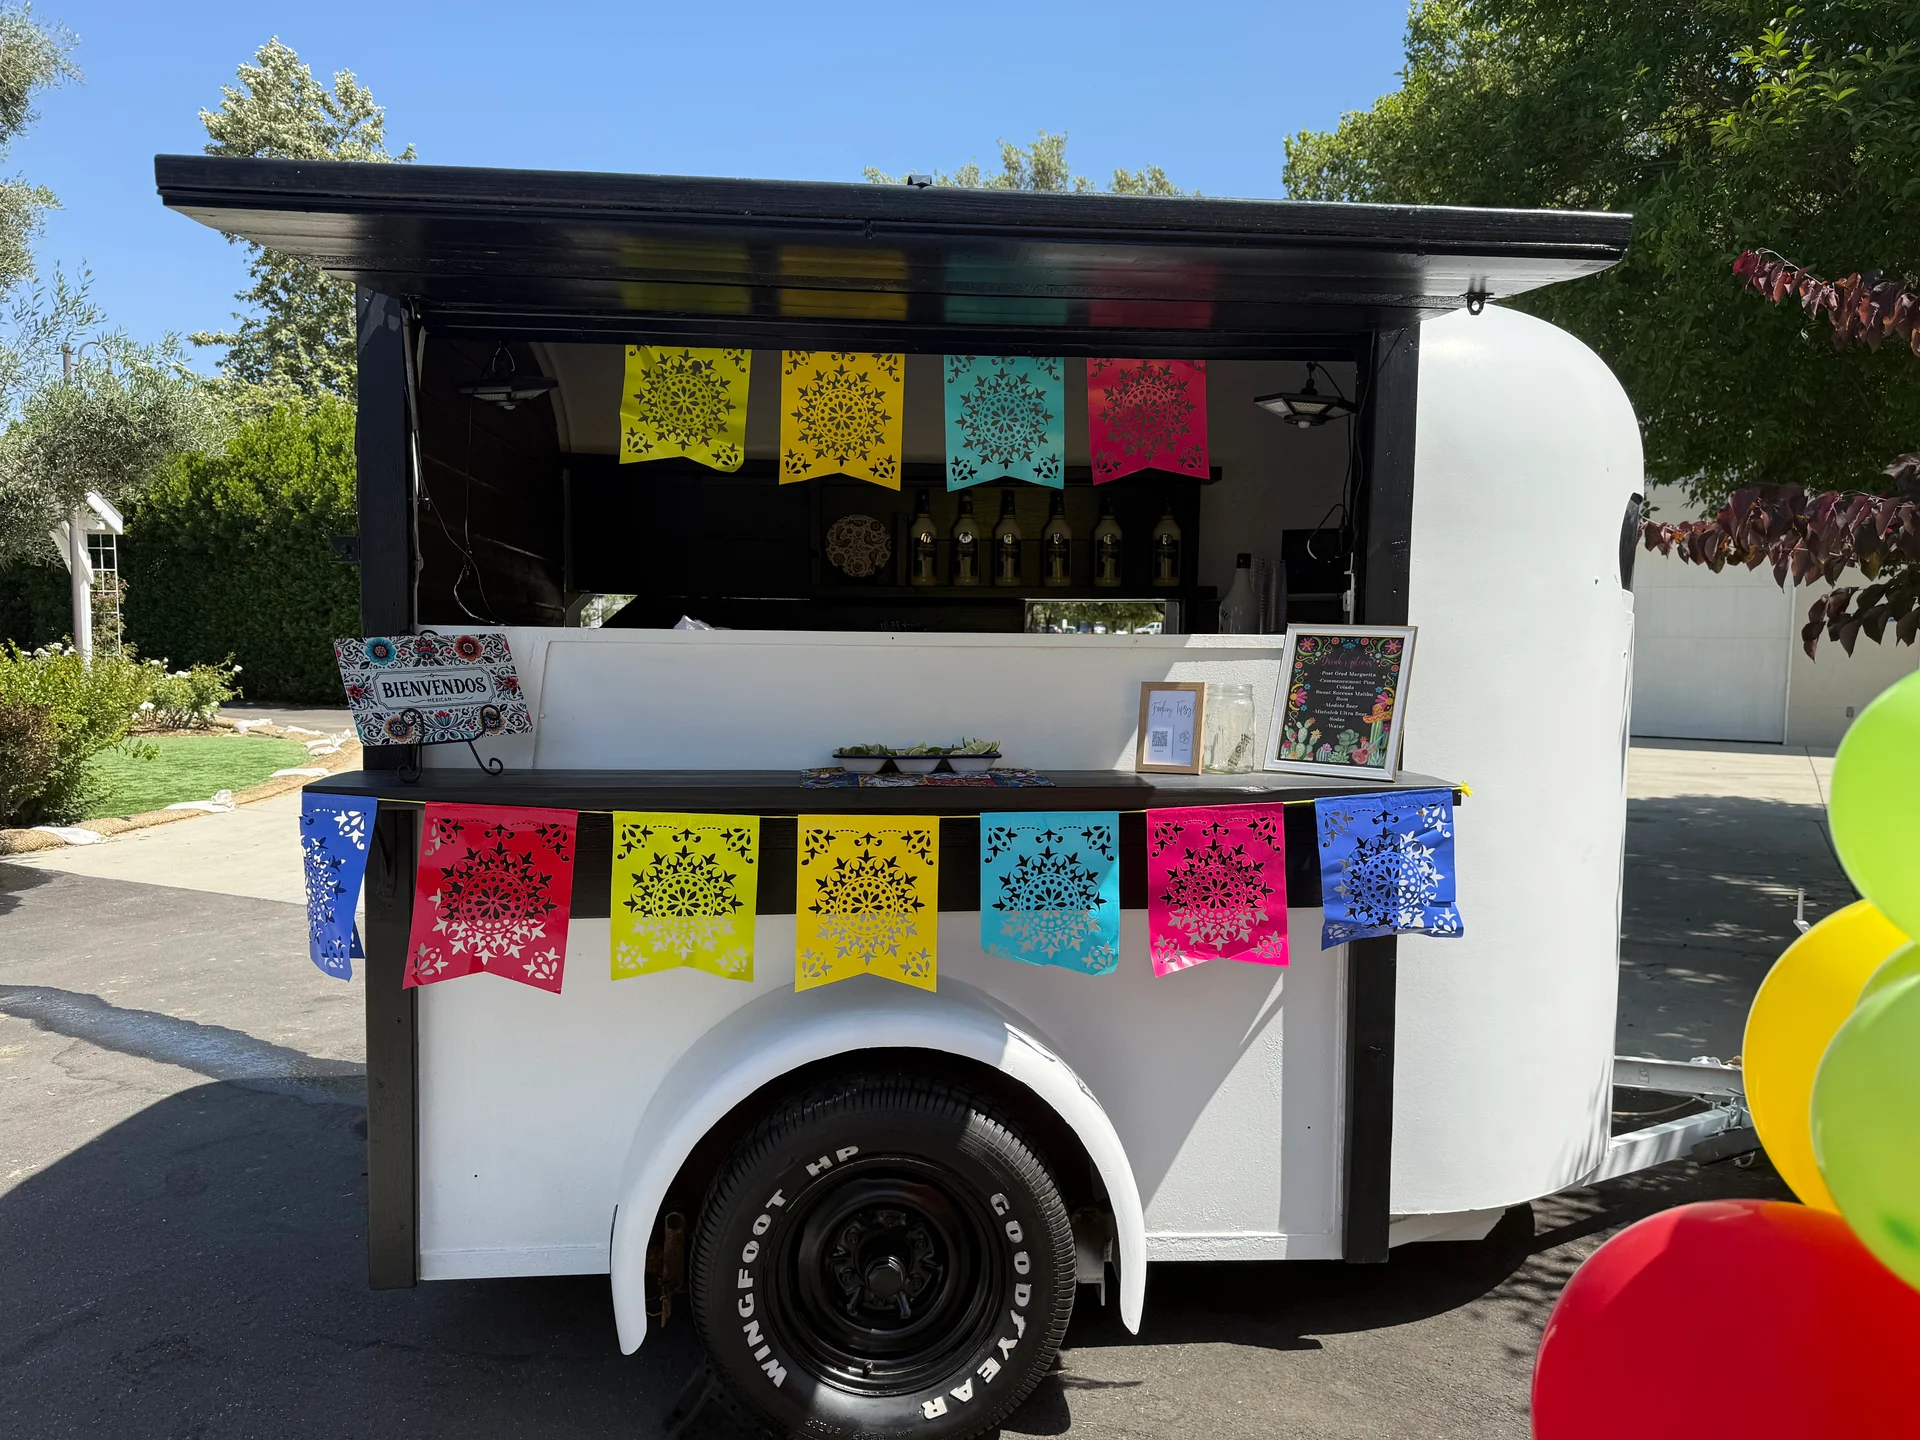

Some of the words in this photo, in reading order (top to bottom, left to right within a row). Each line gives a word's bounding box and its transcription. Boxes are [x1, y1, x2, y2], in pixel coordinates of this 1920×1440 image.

[381, 677, 487, 698] BIENVENDOS
[737, 1188, 789, 1388] WINGFOOT
[805, 1144, 861, 1177] HP
[921, 1192, 1032, 1420] GOODYEAR
